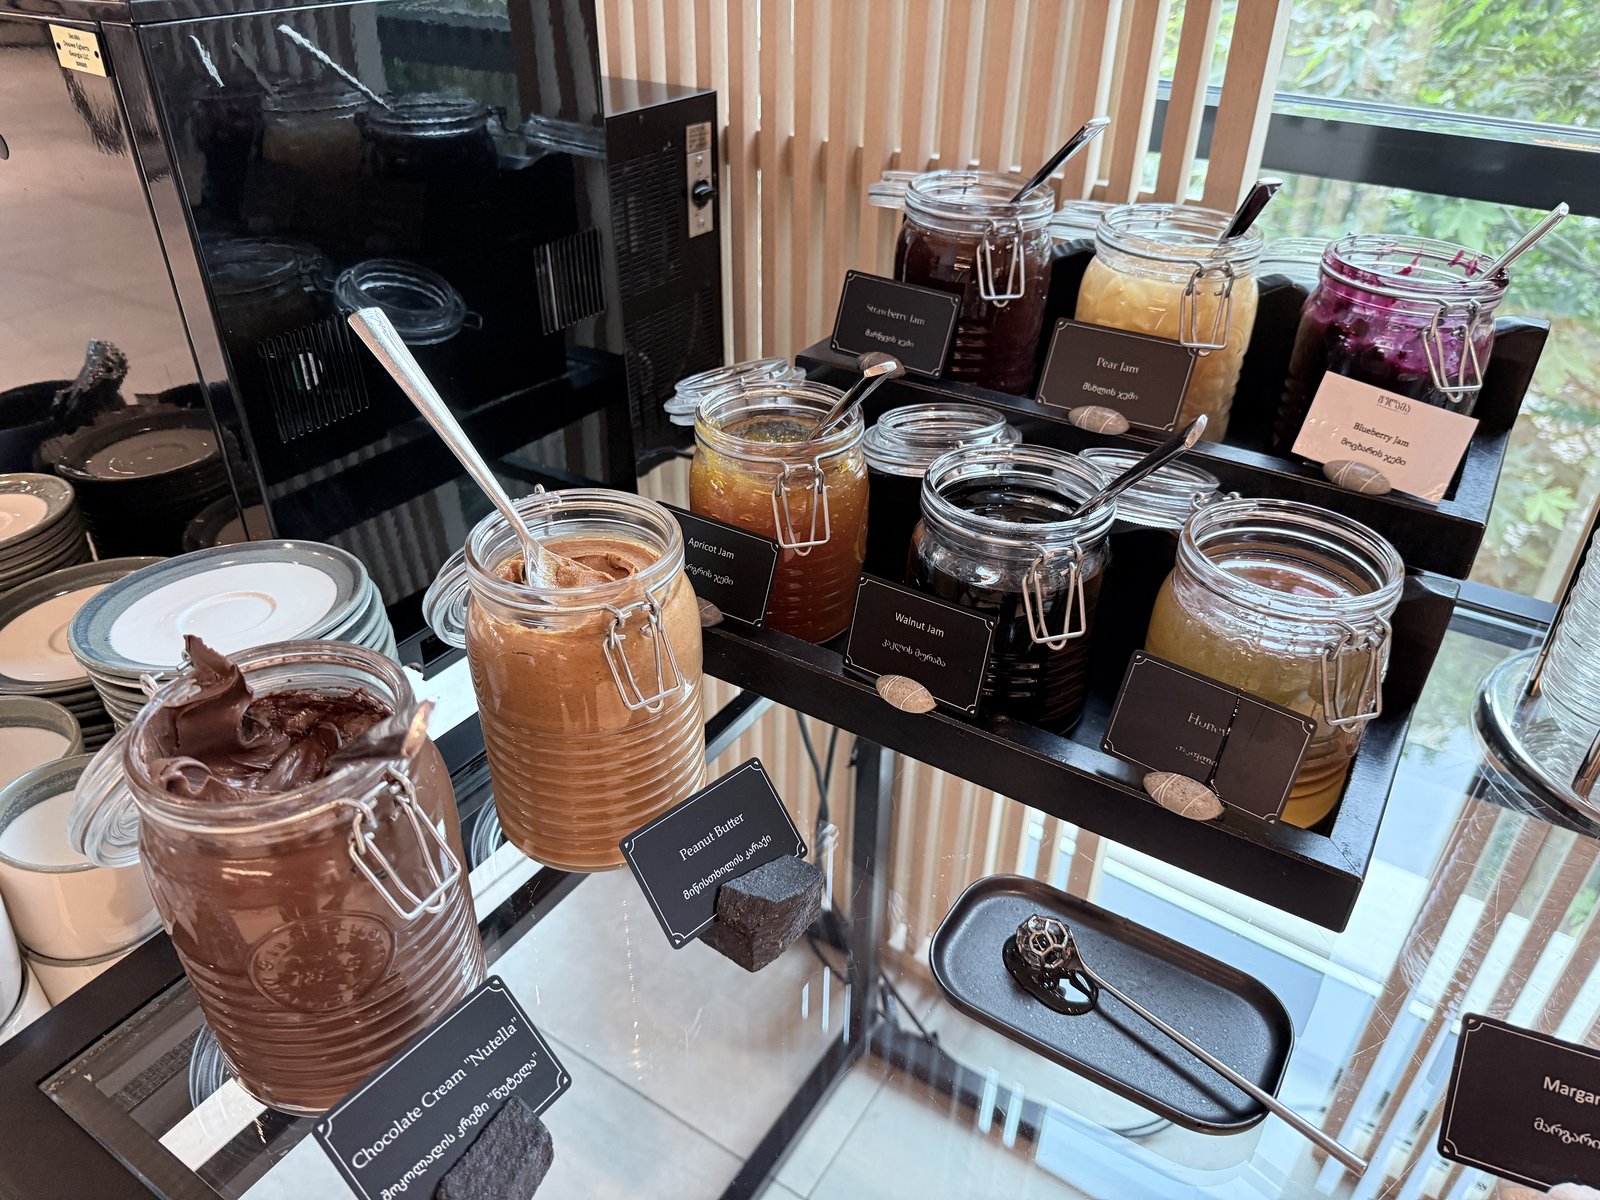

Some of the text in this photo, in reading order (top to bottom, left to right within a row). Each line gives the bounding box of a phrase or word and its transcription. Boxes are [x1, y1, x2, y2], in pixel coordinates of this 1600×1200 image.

[866, 303, 925, 326] Strawberry Jam
[1096, 357, 1139, 374] Pear Jam
[1082, 381, 1139, 401] მსხლის ჯემი
[1353, 422, 1410, 448] Blueberry Jam
[1383, 453, 1406, 466] ჯემი
[688, 537, 735, 560] Apricot Jam
[713, 574, 734, 586] ჯემი
[895, 612, 945, 638] Walnut Jam
[882, 638, 946, 668] კაკლის მურაბა
[679, 813, 745, 862] Peanut Butter
[745, 834, 772, 860] კარაქი
[352, 1016, 519, 1169] Chocolate Cream "Nutella"
[457, 1103, 490, 1138] კრემი
